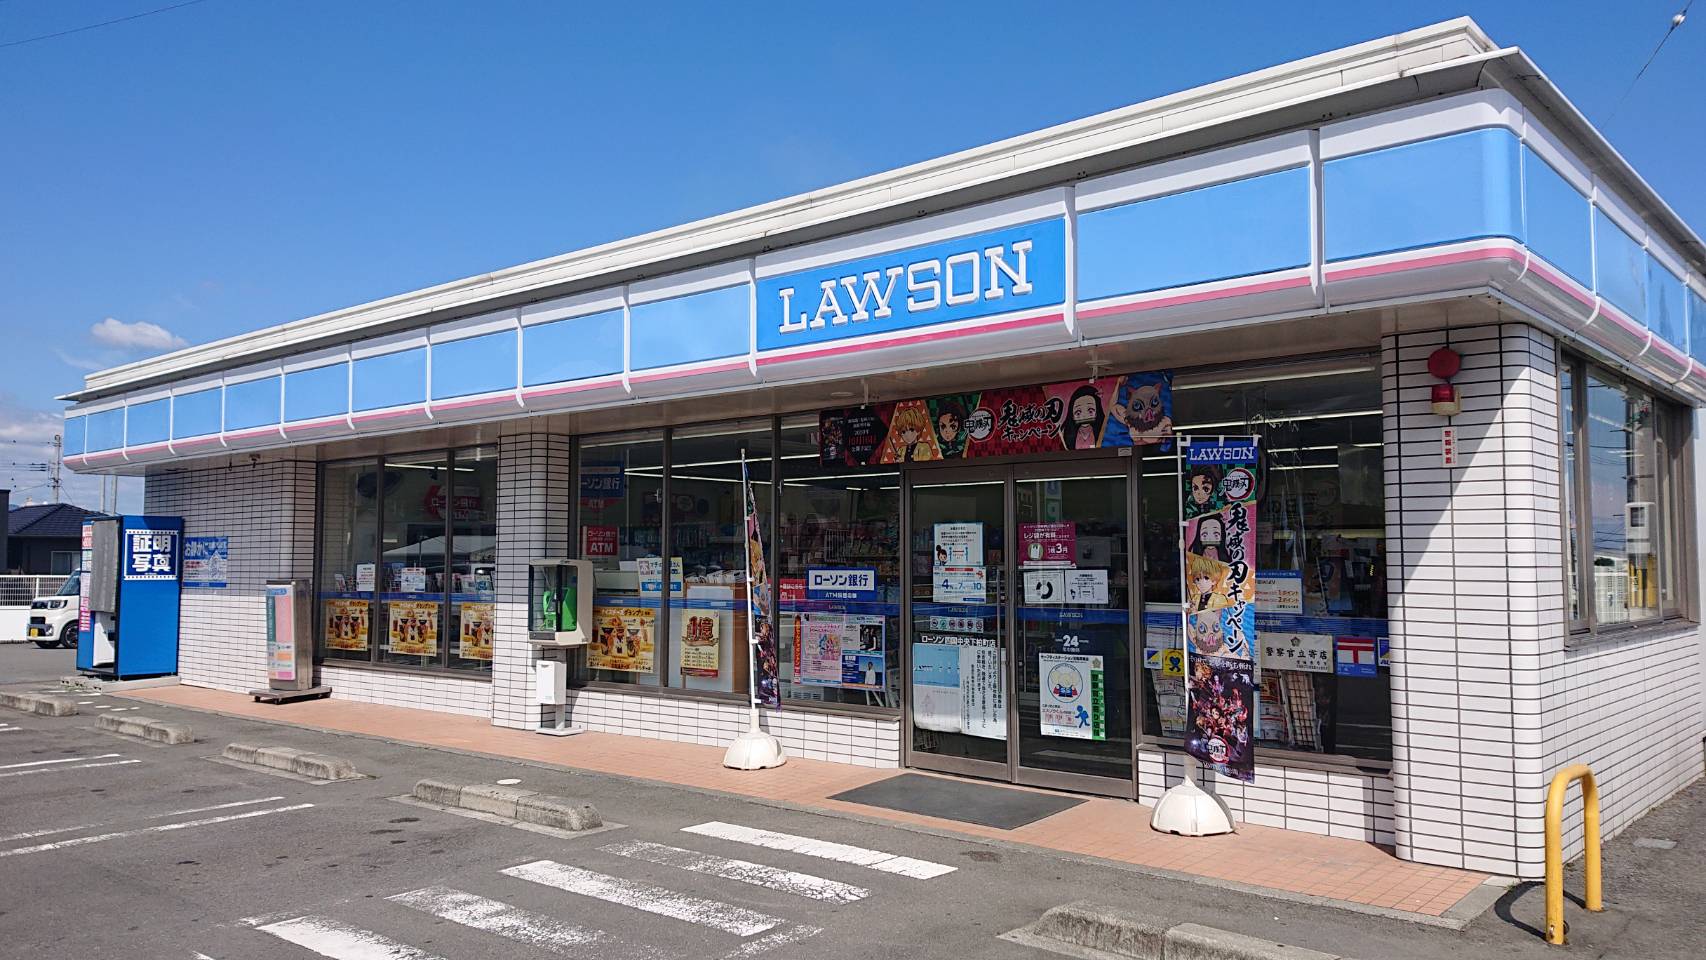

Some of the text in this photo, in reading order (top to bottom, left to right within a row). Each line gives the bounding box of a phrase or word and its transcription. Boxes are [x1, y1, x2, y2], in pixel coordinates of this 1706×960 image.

[779, 240, 1032, 335] LAWSON
[997, 396, 1064, 429] 鬼滅の刃
[1001, 422, 1063, 443] キャンペーン
[1189, 446, 1254, 461] LAWSON
[581, 477, 620, 490] ーソン銀行
[133, 535, 171, 552] 証明
[591, 542, 613, 553] ATM
[132, 553, 171, 572] 写真
[814, 574, 868, 587] ローソン銀行
[1225, 502, 1250, 653] 鬼滅の刃キャンペーン
[1062, 634, 1079, 647] 24
[1266, 646, 1328, 660] 警察官立寄店
